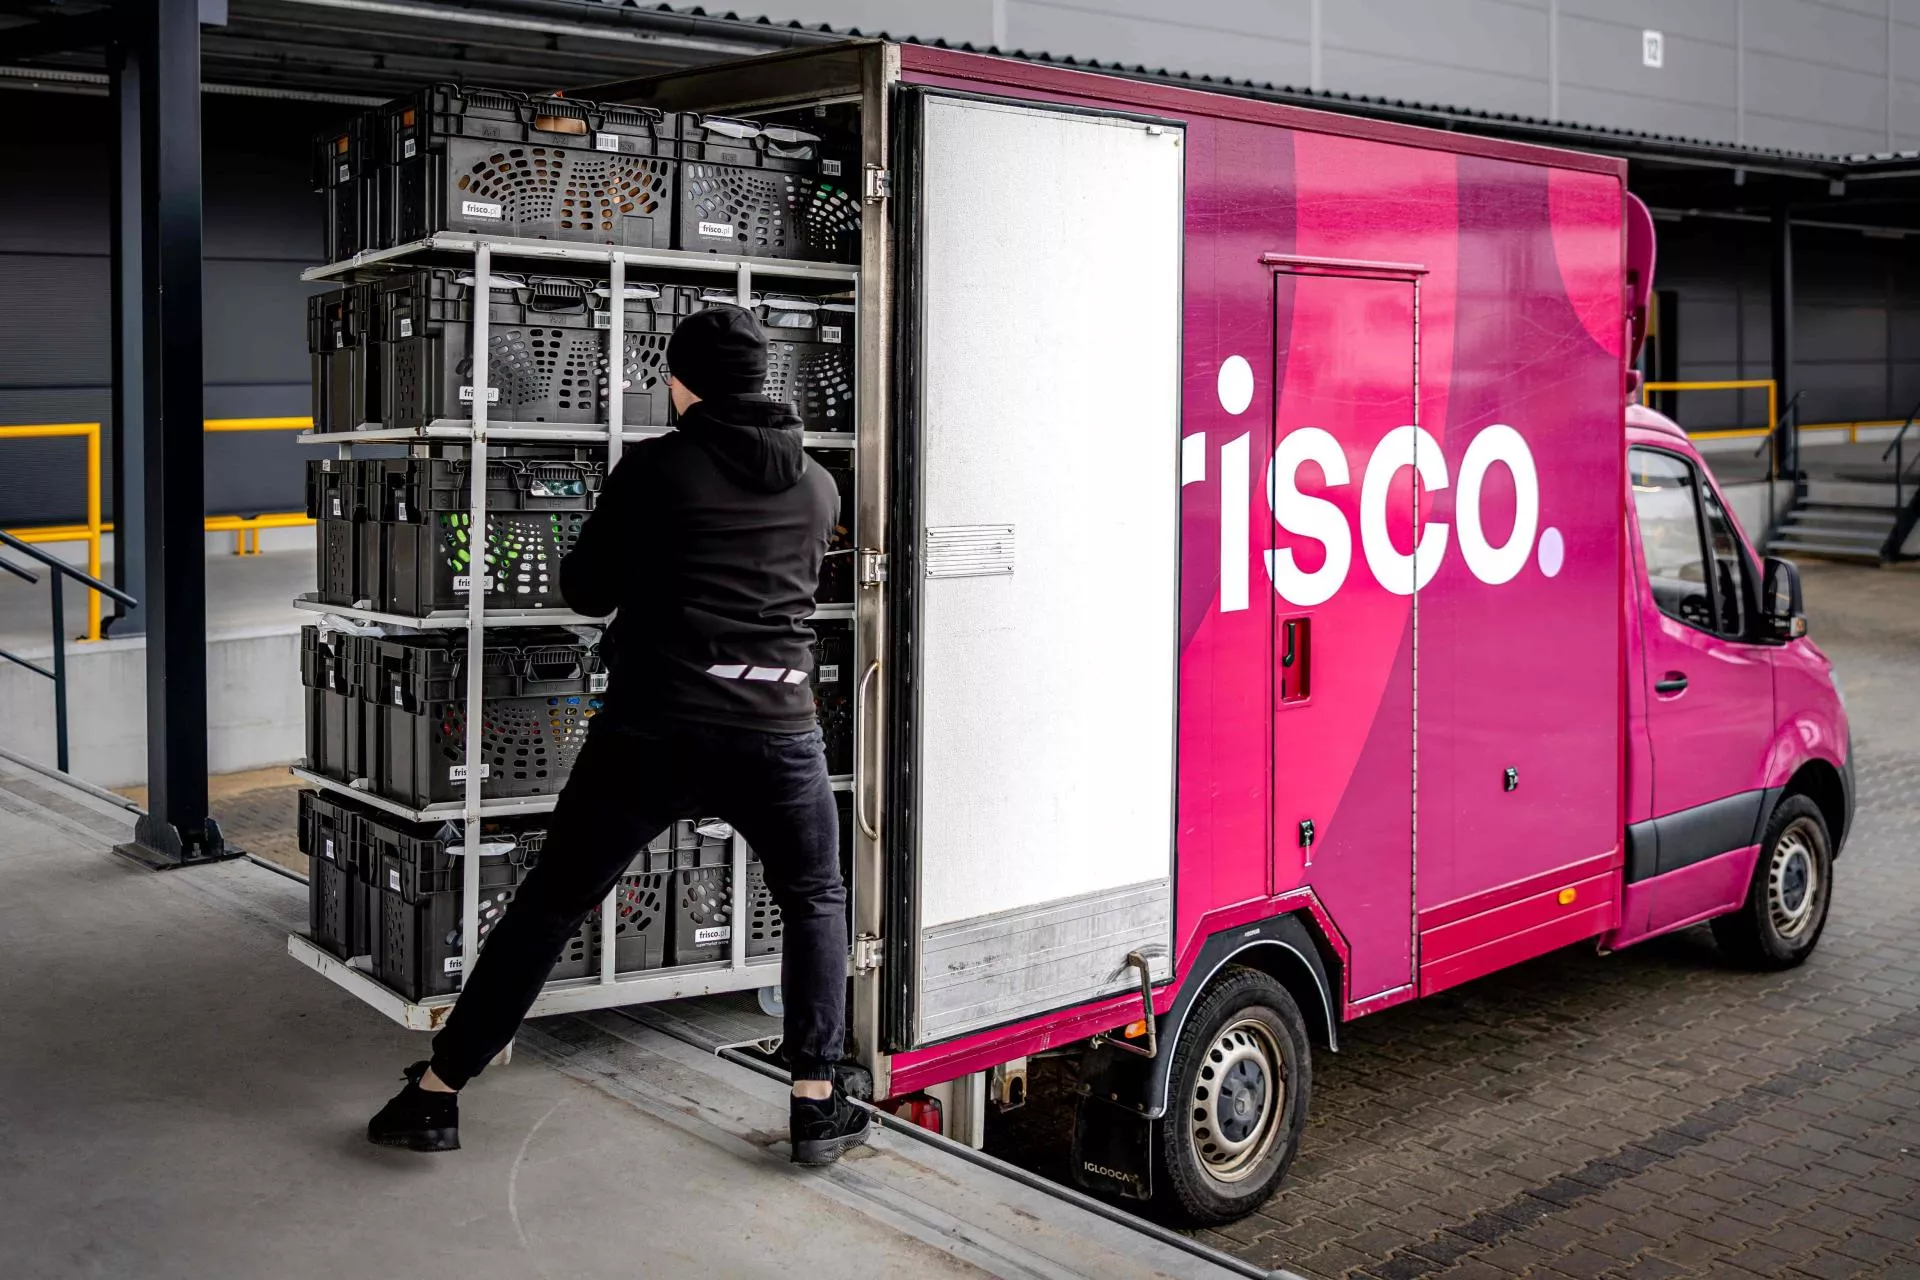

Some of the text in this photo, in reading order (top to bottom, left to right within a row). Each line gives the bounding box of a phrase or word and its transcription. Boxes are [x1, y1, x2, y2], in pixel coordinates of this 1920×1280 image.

[467, 204, 498, 215] frisco.pl
[703, 225, 730, 235] frisco.pl
[464, 388, 494, 399] fripl
[699, 929, 727, 939] frisco.pl
